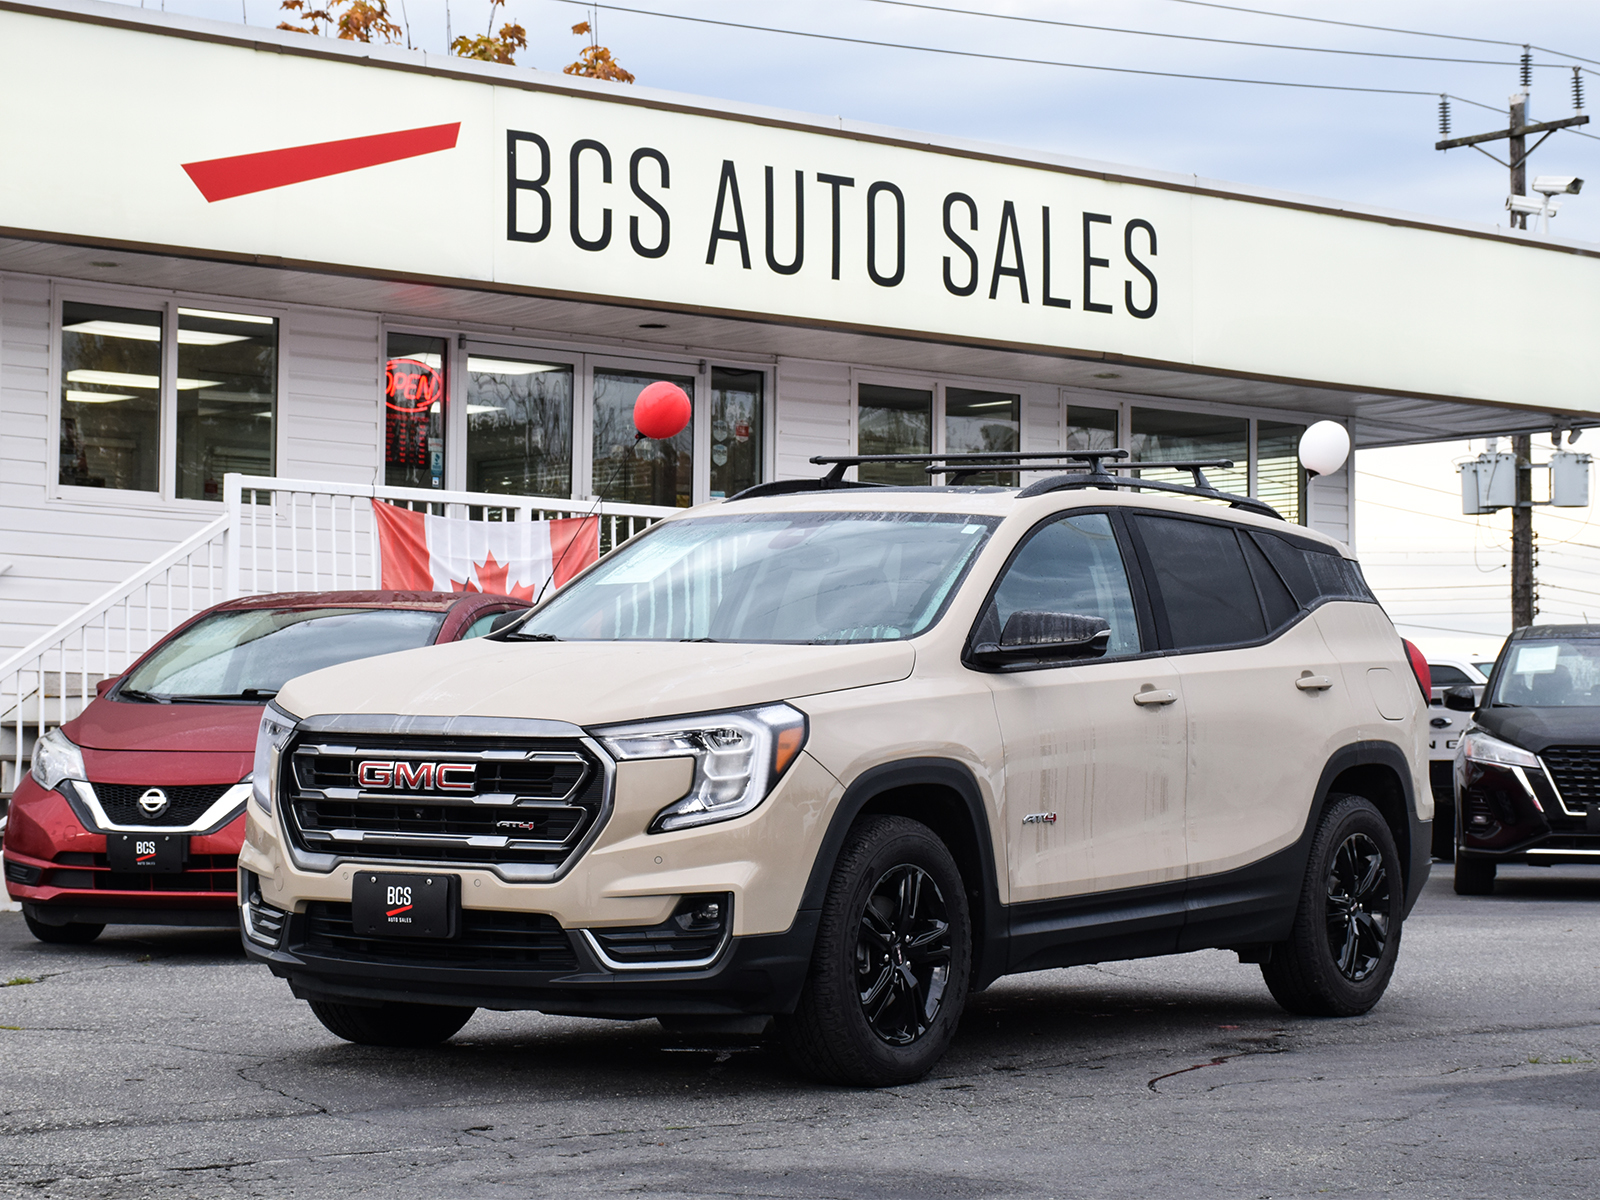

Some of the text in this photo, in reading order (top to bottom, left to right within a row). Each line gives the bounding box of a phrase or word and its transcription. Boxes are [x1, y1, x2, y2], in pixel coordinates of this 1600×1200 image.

[506, 128, 1158, 320] BCS AUTO SALES
[358, 760, 477, 792] GMC
[1022, 811, 1057, 825] AT4
[136, 841, 155, 854] BCS
[387, 886, 412, 905] BCS
